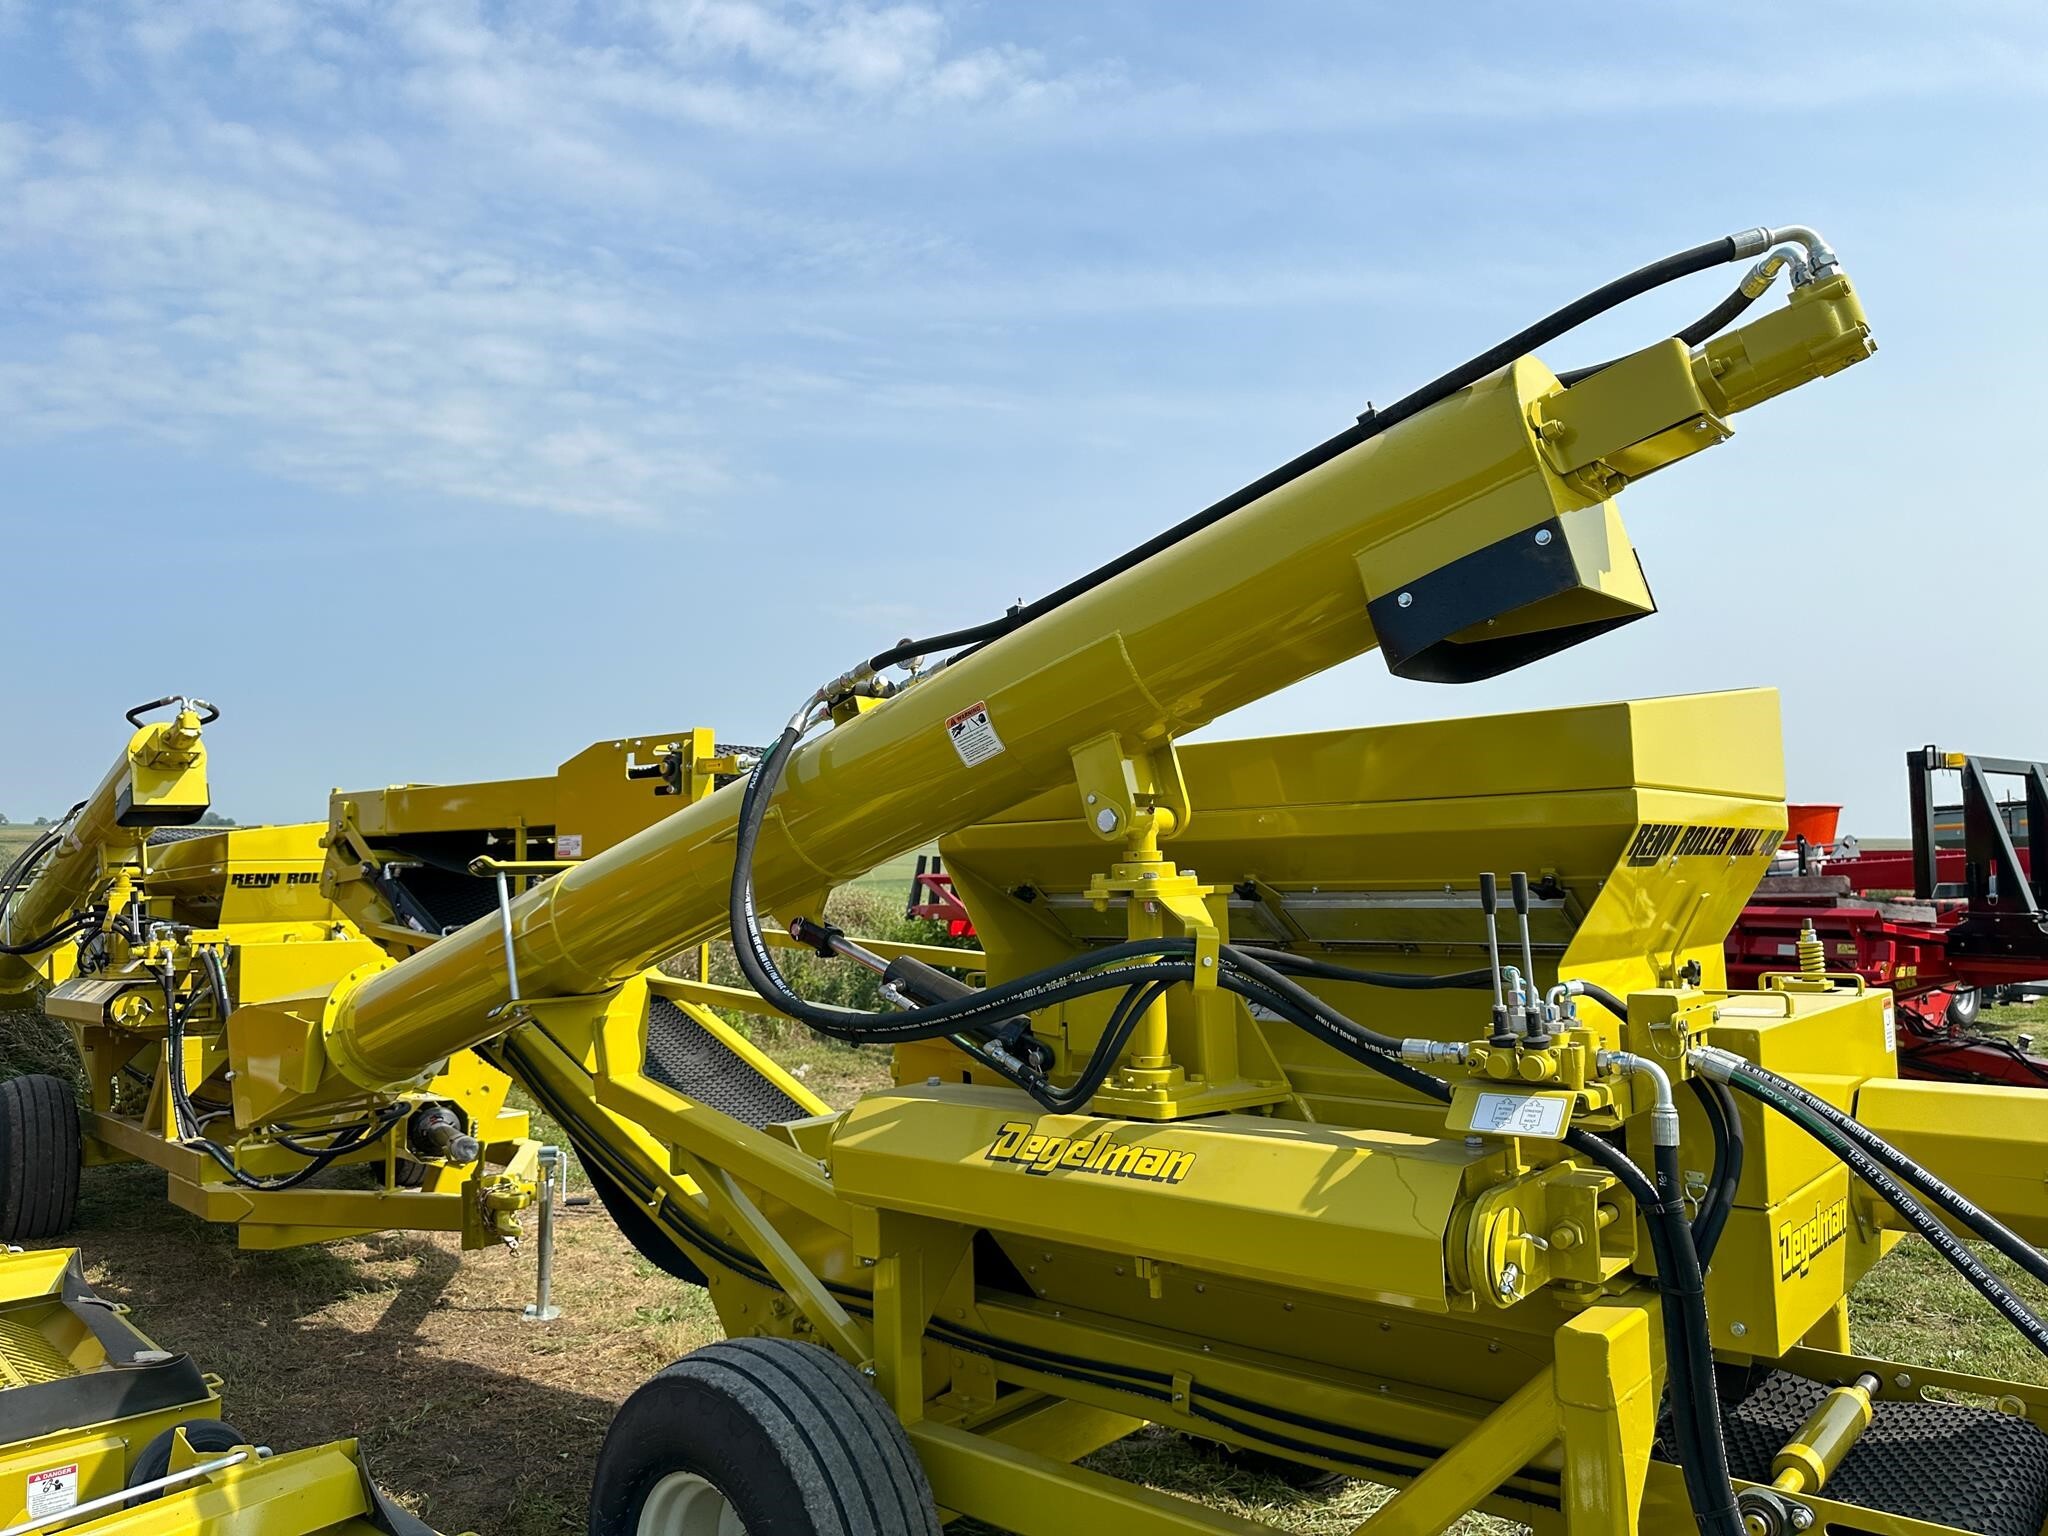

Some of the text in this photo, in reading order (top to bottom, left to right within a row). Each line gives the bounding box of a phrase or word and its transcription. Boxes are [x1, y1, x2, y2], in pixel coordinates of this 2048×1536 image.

[1626, 823, 1683, 867] RENN
[1673, 826, 1735, 856] ROLLER
[1726, 828, 1764, 856] MILL
[231, 873, 280, 889] RENN
[1757, 1084, 1788, 1107] NOVA
[985, 1121, 1196, 1185] Degelman
[1752, 1068, 1771, 1081] BAR
[1772, 1076, 1787, 1090] WP
[1787, 1085, 1804, 1099] SAE
[1804, 1095, 1842, 1122] 100R2AT
[1842, 1116, 1868, 1140] MSHA
[1867, 1135, 1908, 1166] IC-188/4
[1913, 1167, 1940, 1191] MADE
[1939, 1185, 1953, 1201] IN
[1951, 1193, 1979, 1217] ITALY
[1778, 1196, 1847, 1282] Degelman
[1847, 1149, 1878, 1177] 122-12
[1875, 1175, 1897, 1193] 3/4"
[1893, 1190, 1917, 1215] 3100
[1914, 1210, 1931, 1228] PSI
[1933, 1230, 1953, 1250] 215
[1949, 1246, 1971, 1267] BAR
[1968, 1263, 1985, 1281] WP
[1983, 1279, 2003, 1298] SAE
[2001, 1295, 2041, 1333] 100R2AT
[42, 1467, 72, 1479] DANGER
